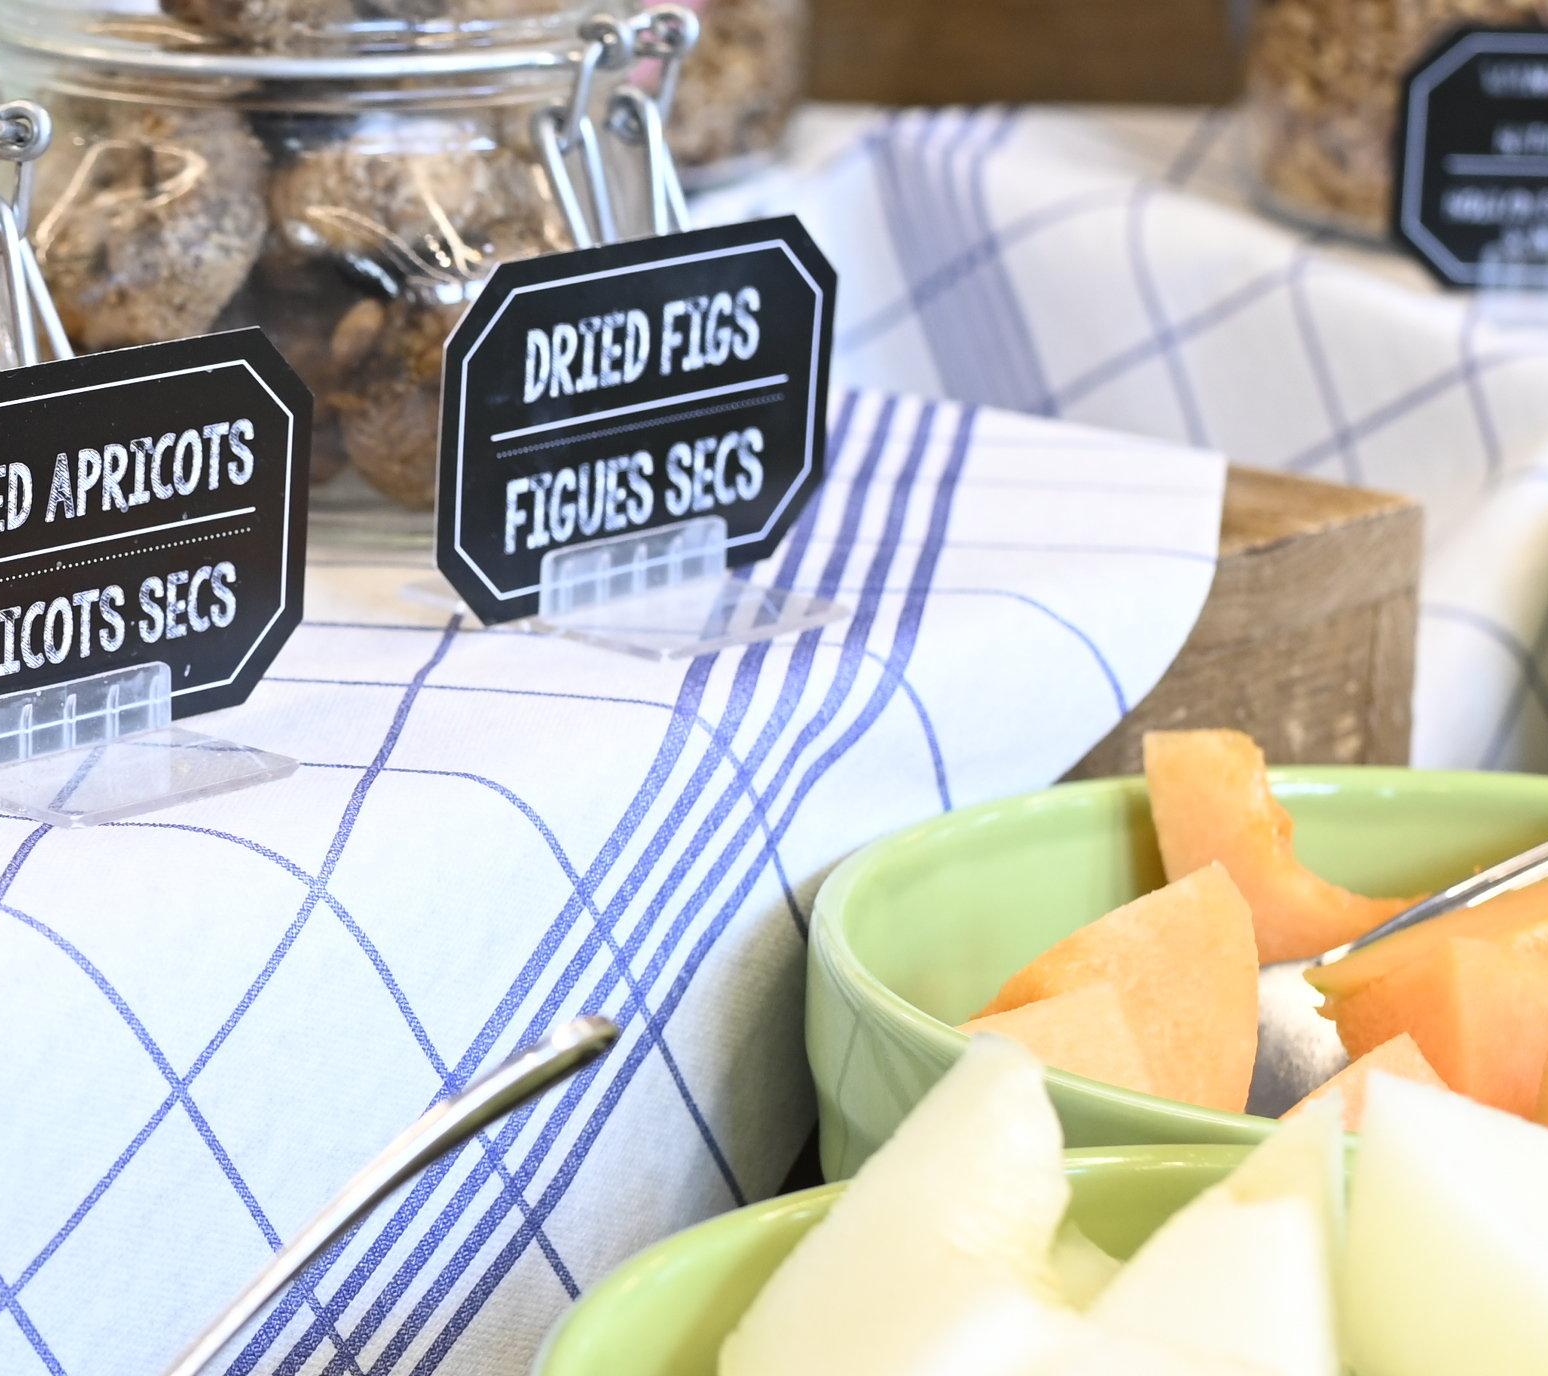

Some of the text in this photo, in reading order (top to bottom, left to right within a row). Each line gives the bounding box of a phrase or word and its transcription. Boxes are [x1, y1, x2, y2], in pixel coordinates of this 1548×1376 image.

[523, 286, 761, 404] DRIED FIGS
[44, 417, 256, 524] APRICOTS
[504, 426, 764, 554] FIGUES SECS
[138, 560, 237, 644] SECS
